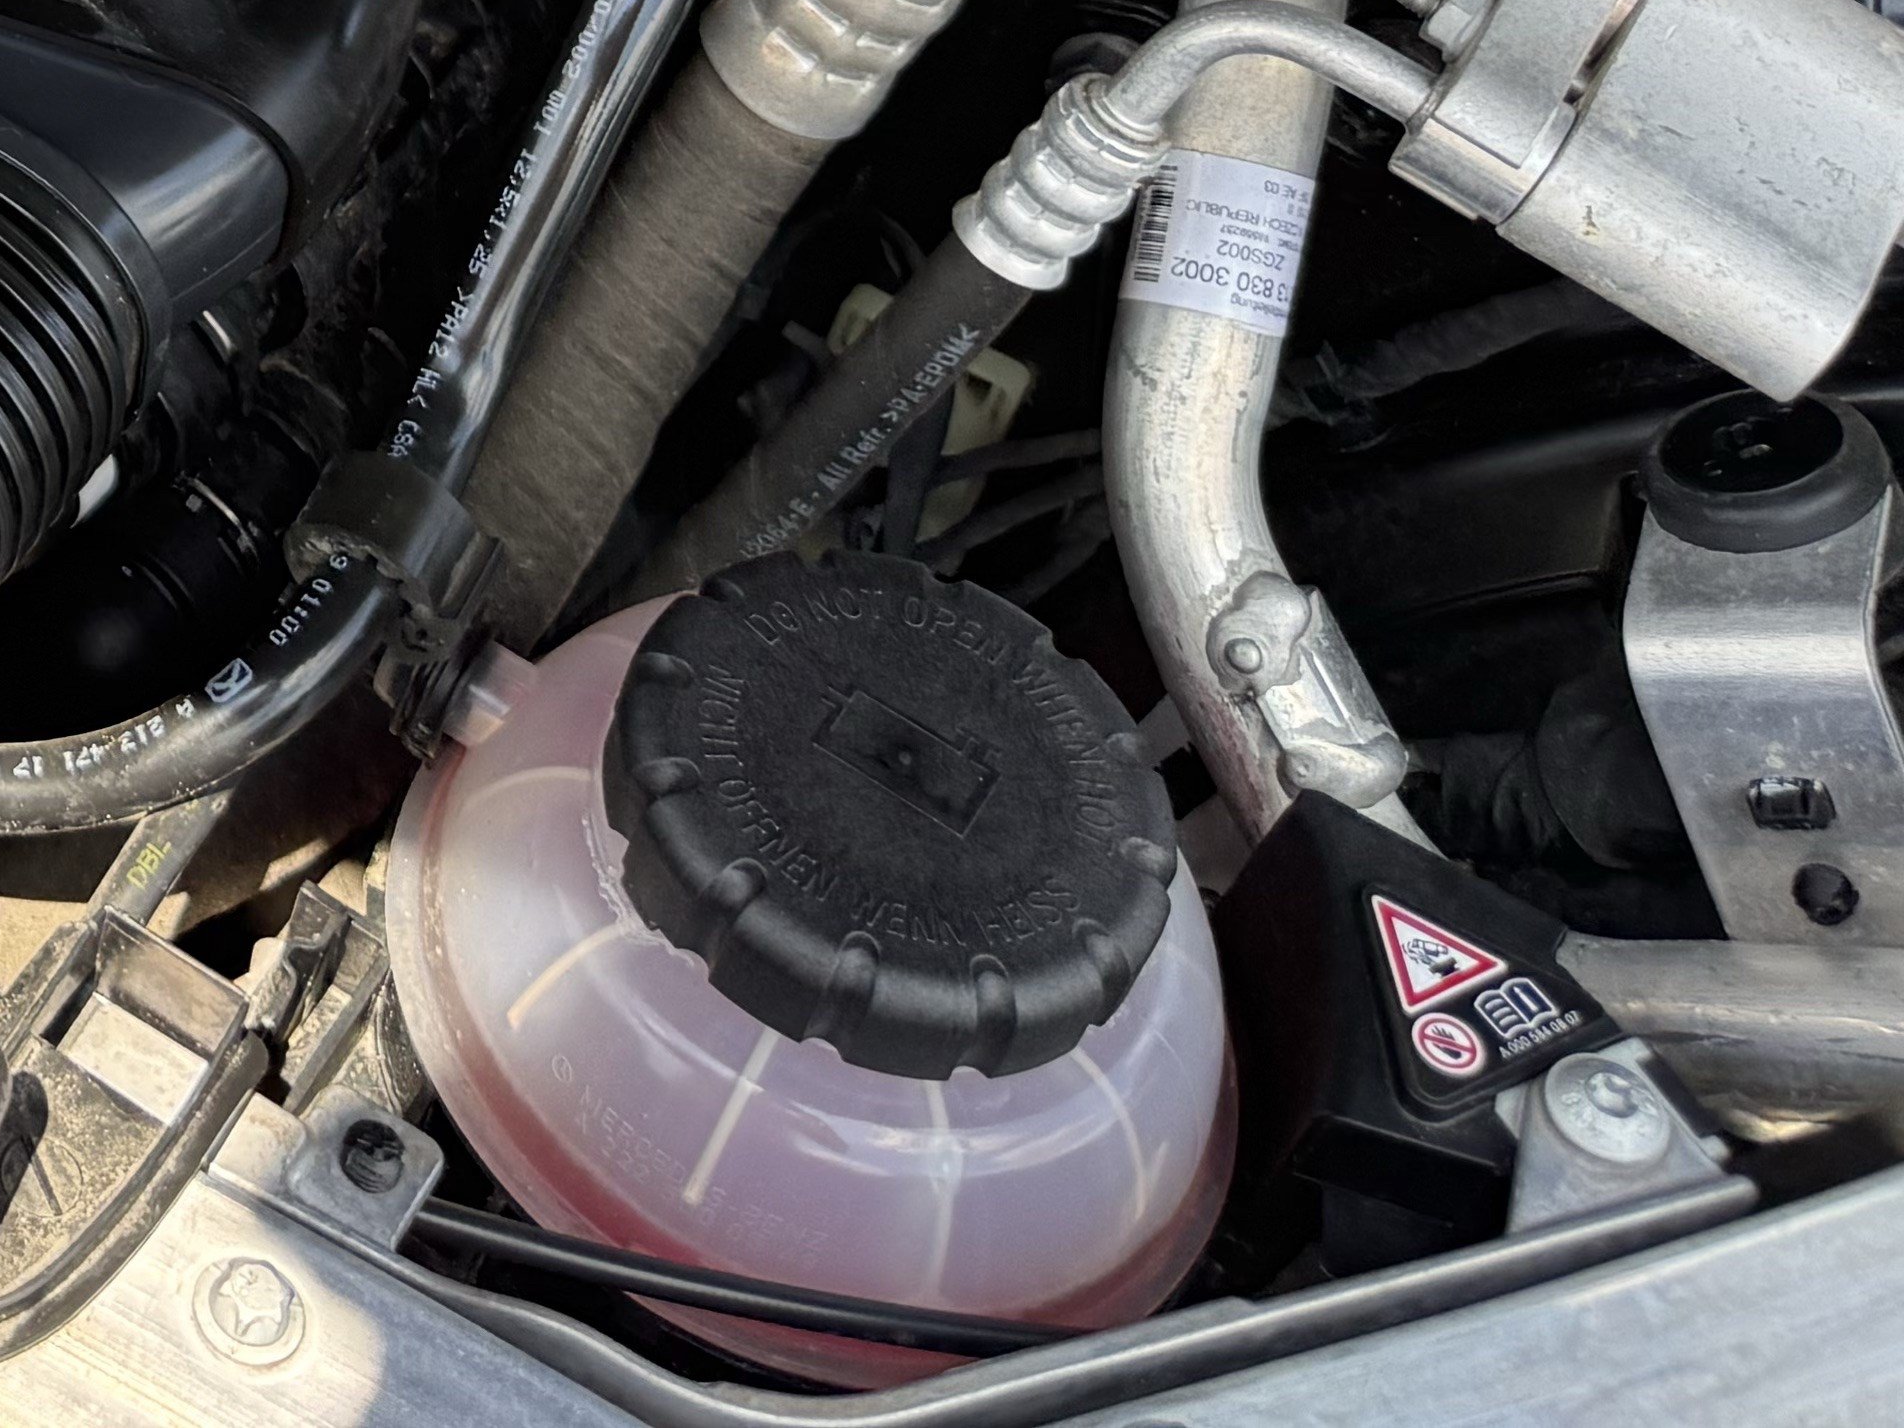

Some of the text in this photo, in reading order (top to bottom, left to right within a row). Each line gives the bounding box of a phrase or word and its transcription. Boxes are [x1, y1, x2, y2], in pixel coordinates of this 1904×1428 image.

[1186, 199, 1260, 226] REPUBLIC
[1216, 239, 1286, 271] ZGS002
[1170, 256, 1231, 287] 3002
[1237, 271, 1275, 298] 830
[269, 578, 333, 647] 01:00
[743, 586, 1123, 857] DO NOT OPEN WHEN HOT
[698, 662, 747, 767] NICHT
[850, 893, 967, 948] WENN
[971, 877, 1081, 947] HEISS
[1499, 1045, 1512, 1060] A
[1507, 1035, 1531, 1054] 000
